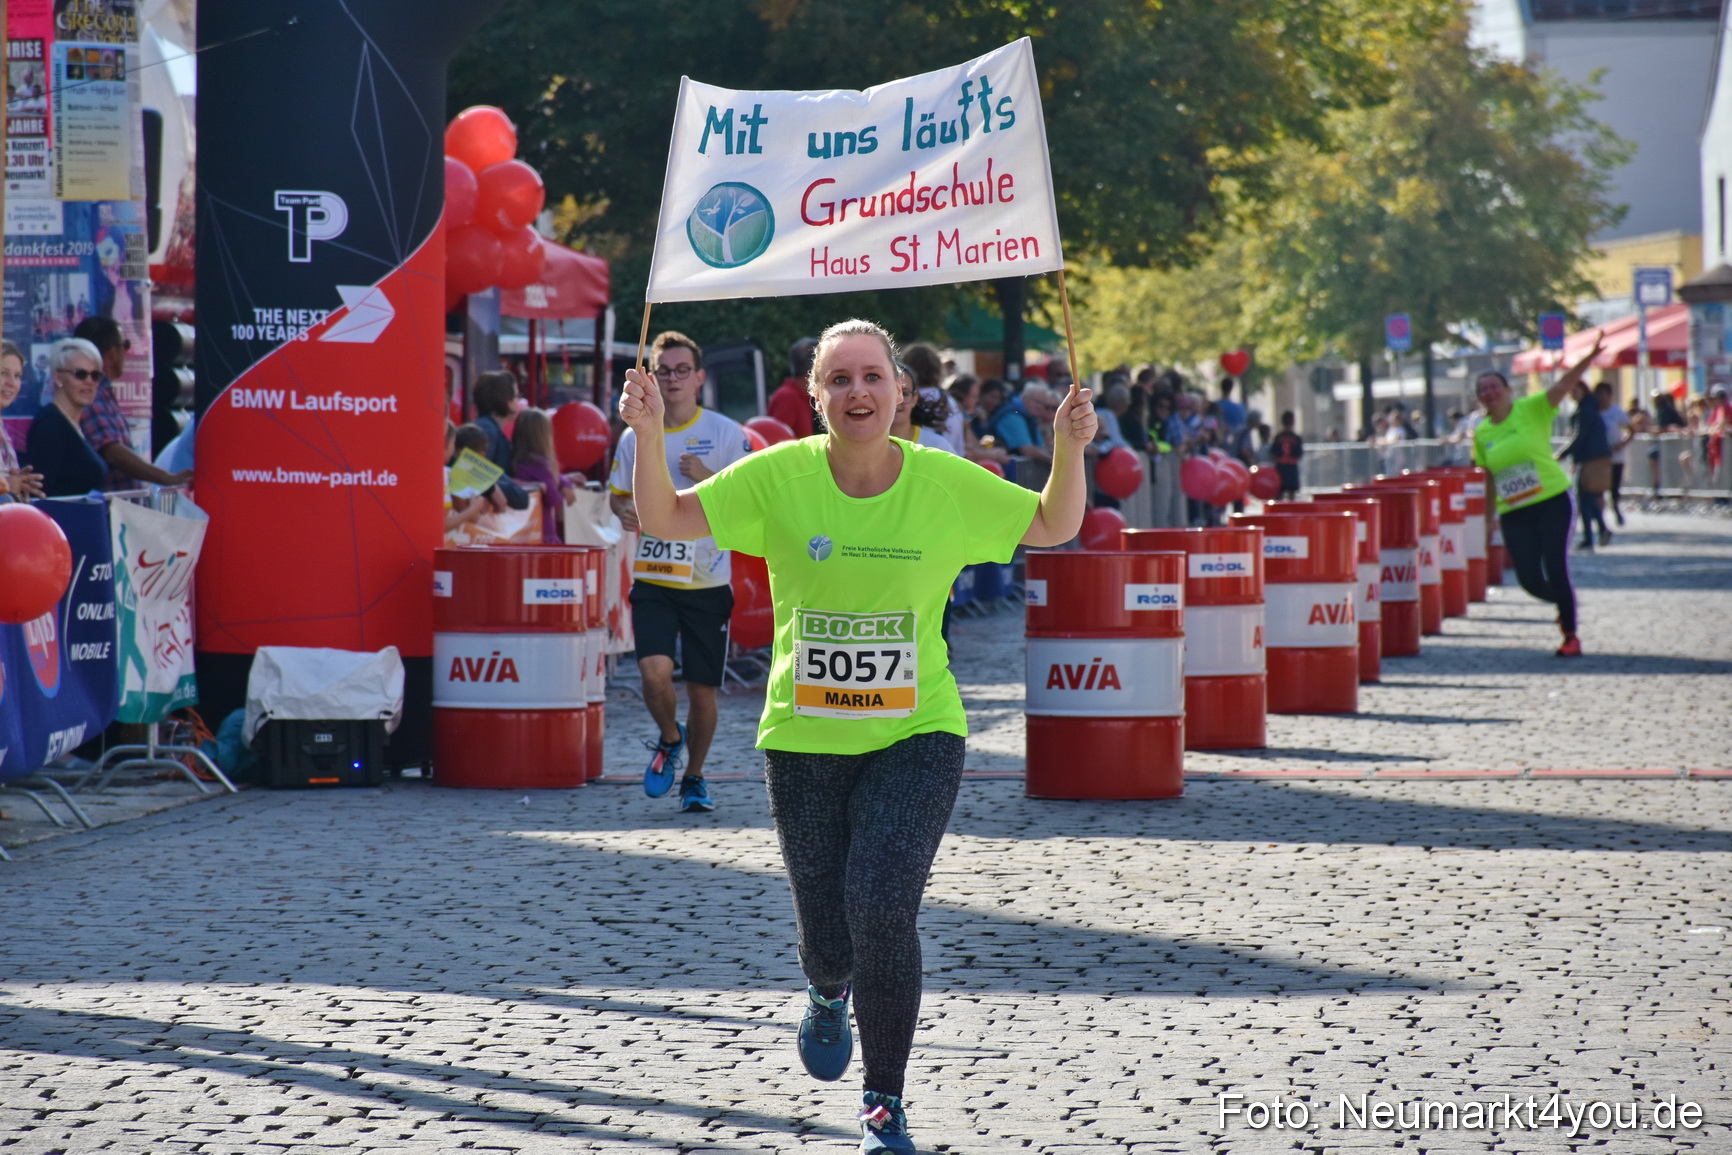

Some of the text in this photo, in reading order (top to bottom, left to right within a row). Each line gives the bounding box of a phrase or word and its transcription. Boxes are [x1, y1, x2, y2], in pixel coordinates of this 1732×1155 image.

[8, 118, 45, 135] JAHRE
[698, 75, 1016, 160] Mit uns läufts
[55, 63, 63, 197] Kakteen und andere Sukkulenten
[12, 139, 45, 151] Konzert
[28, 153, 45, 167] Uhr
[279, 196, 301, 205] Team
[800, 157, 1015, 228] Grundschule
[4, 241, 95, 258] dankfest 2019
[810, 228, 1040, 278] Haus St. Marien
[253, 307, 329, 326] THE NEXT
[231, 324, 310, 342] 100 YEARS
[230, 388, 397, 416] BMW Laufsport
[231, 467, 398, 488] www.bmw-partl.de
[641, 541, 687, 561] 5013
[857, 545, 891, 553] katholische
[891, 547, 922, 555] Volksschule
[89, 564, 113, 581] STO
[646, 563, 673, 574] DAVID
[802, 612, 906, 640] BOCK
[70, 641, 111, 661] MOBILE
[449, 651, 520, 683] AVIA
[807, 647, 902, 683] 5057
[1046, 657, 1122, 691] AVIA
[824, 691, 885, 708] MARIA
